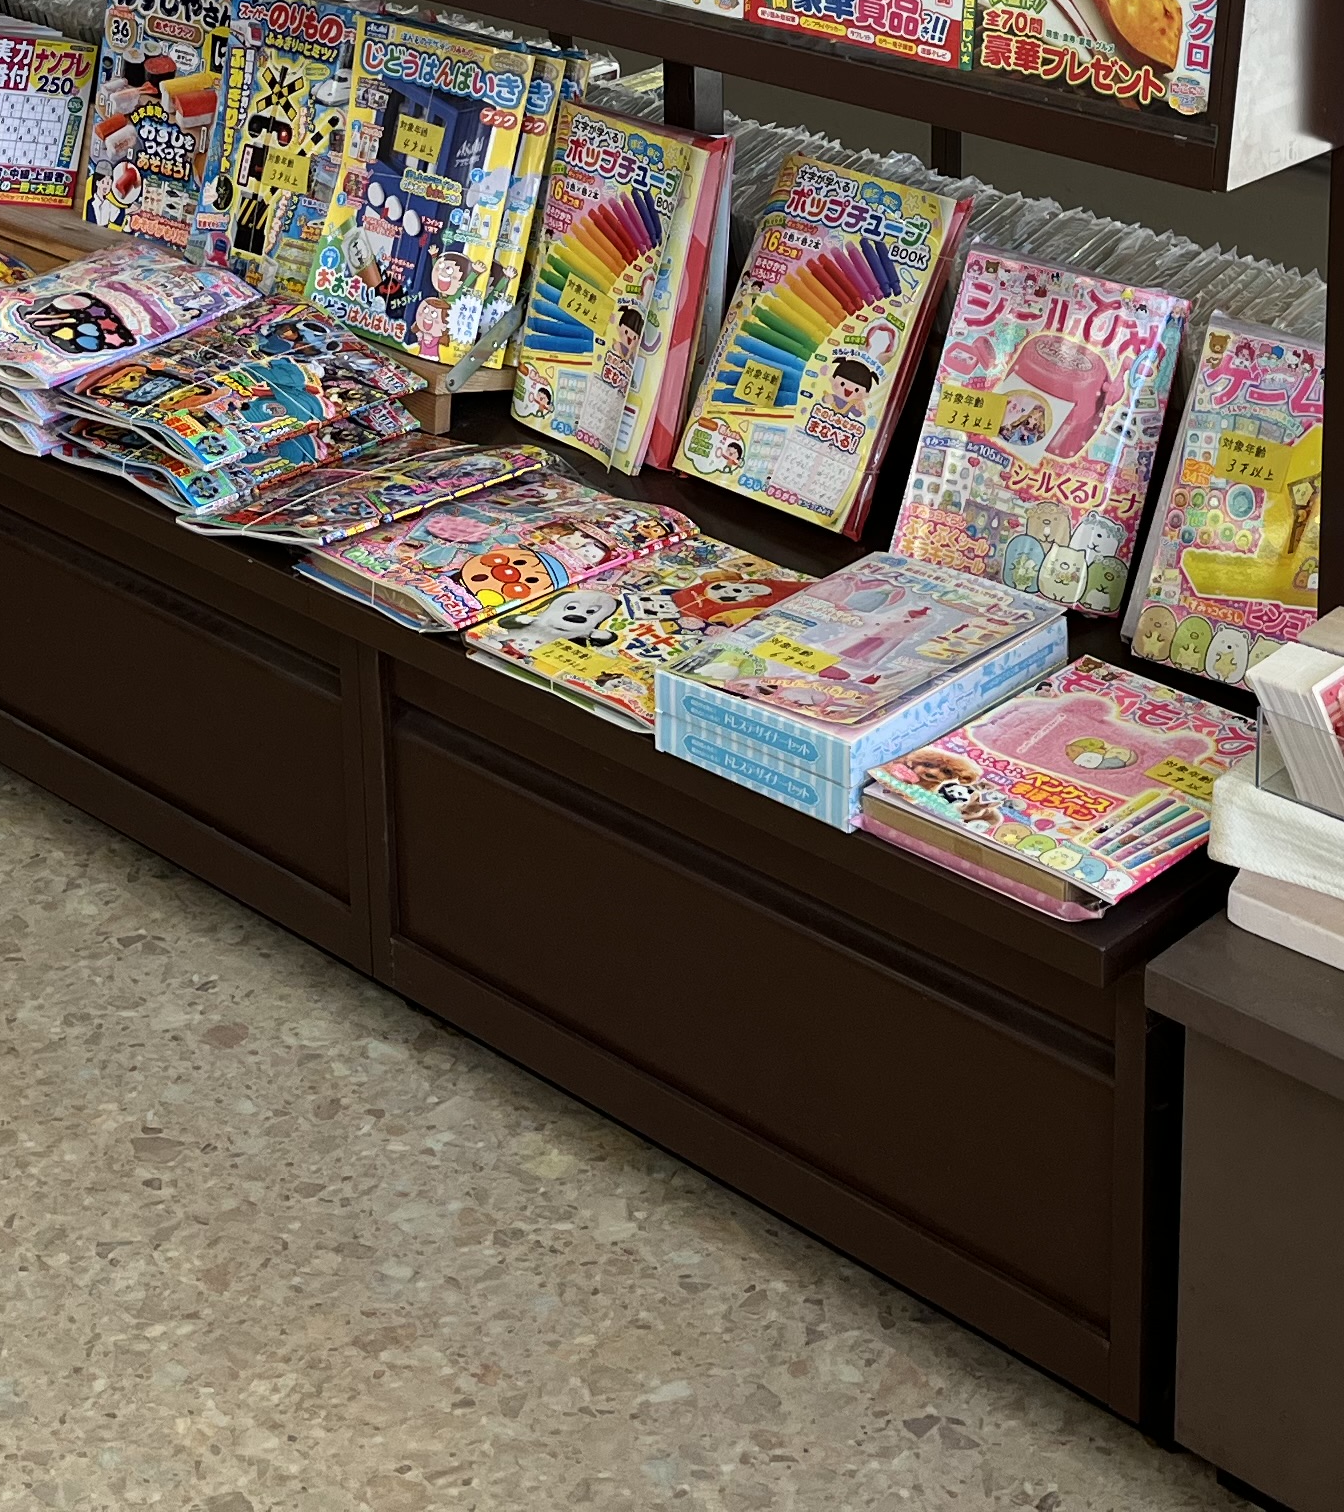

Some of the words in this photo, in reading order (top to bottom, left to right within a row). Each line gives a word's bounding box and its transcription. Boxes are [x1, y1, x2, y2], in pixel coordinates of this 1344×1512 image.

[269, 1, 344, 45] のりもの
[985, 11, 1043, 36] 全70問
[33, 49, 93, 79] ナンプレ
[361, 40, 525, 107] じどうはんばいき
[980, 35, 1165, 104] 豪華プレゼント
[35, 76, 73, 96] 250
[480, 108, 517, 129] ブック
[573, 116, 626, 148] 文字が学べる!
[565, 138, 682, 197] ポップチューブ
[797, 167, 859, 197] 文字が学べる!
[785, 187, 930, 248] ポップチューブ
[762, 228, 780, 254] 16
[889, 244, 928, 270] BOOK
[315, 268, 375, 303] おおきい
[940, 390, 985, 409] 対象年齢
[806, 416, 859, 454] まなべる!
[1221, 436, 1269, 459] 対象年齢
[1009, 464, 1141, 517] シールくるリーナ
